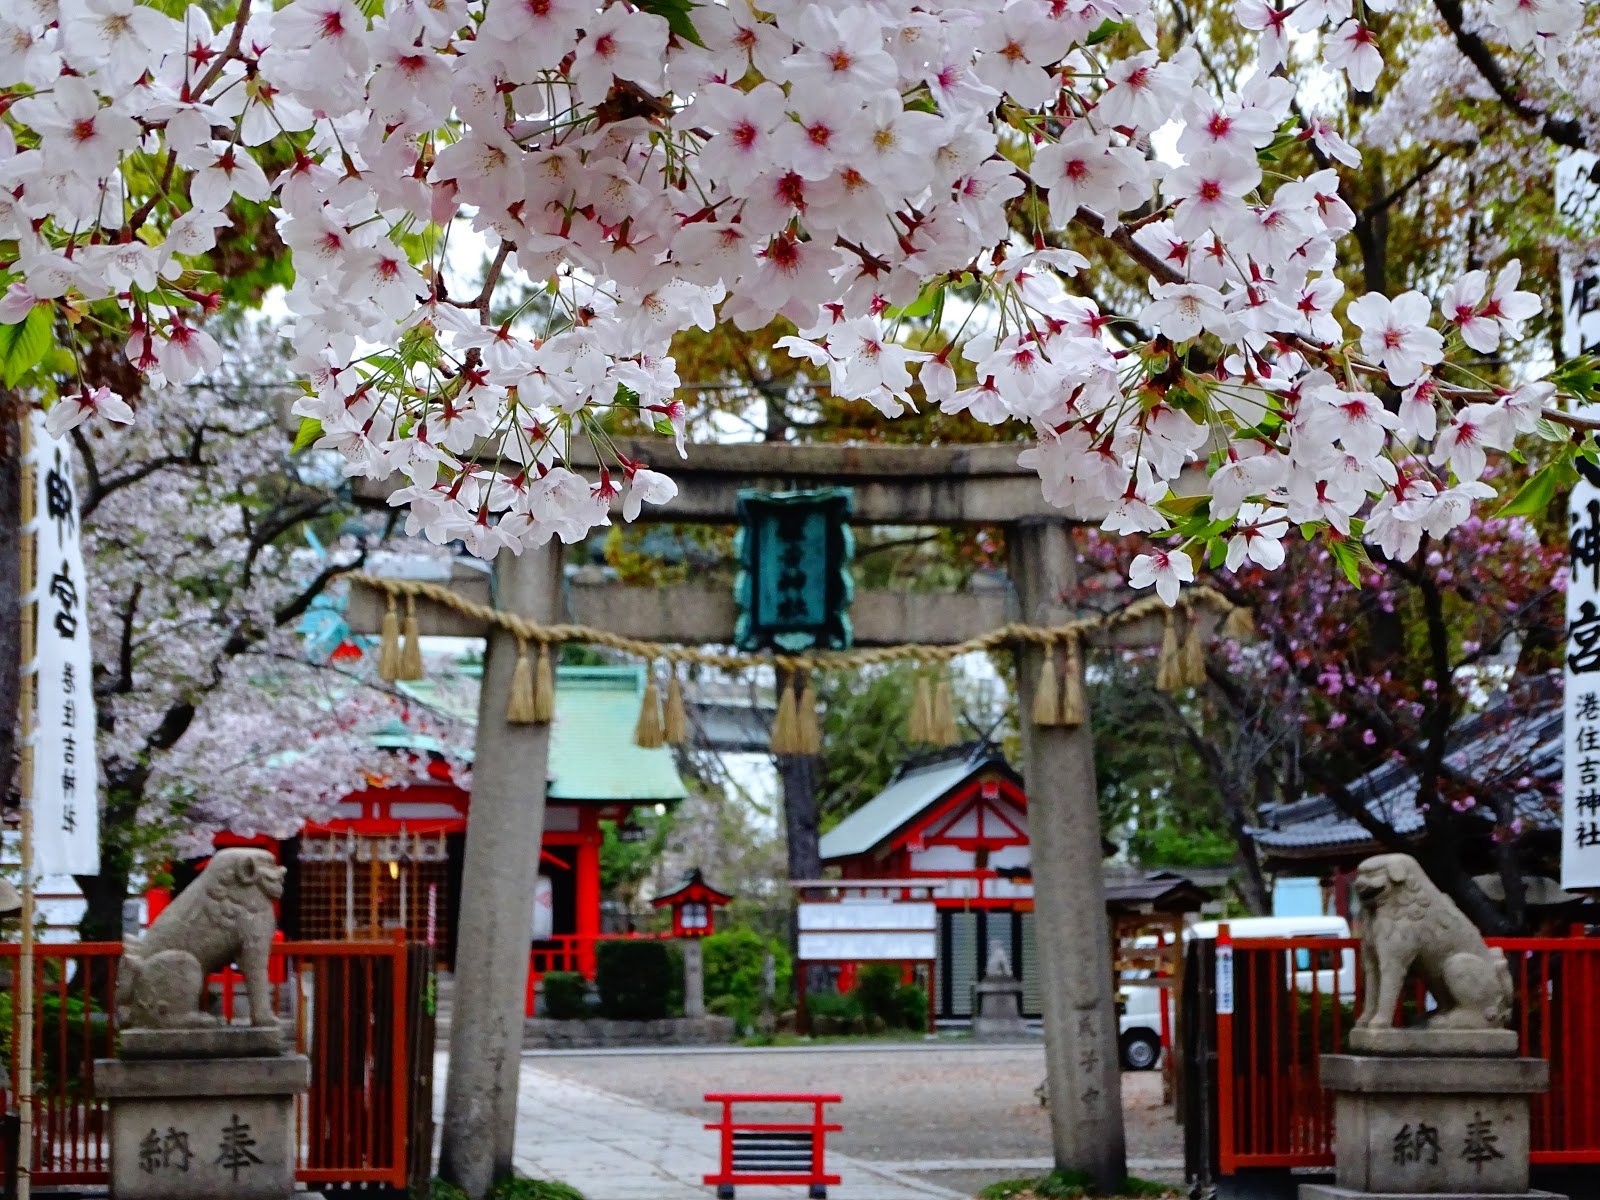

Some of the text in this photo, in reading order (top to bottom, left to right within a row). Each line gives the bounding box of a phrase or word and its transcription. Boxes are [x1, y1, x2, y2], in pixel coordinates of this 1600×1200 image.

[1575, 690, 1600, 850] 港住吉神社
